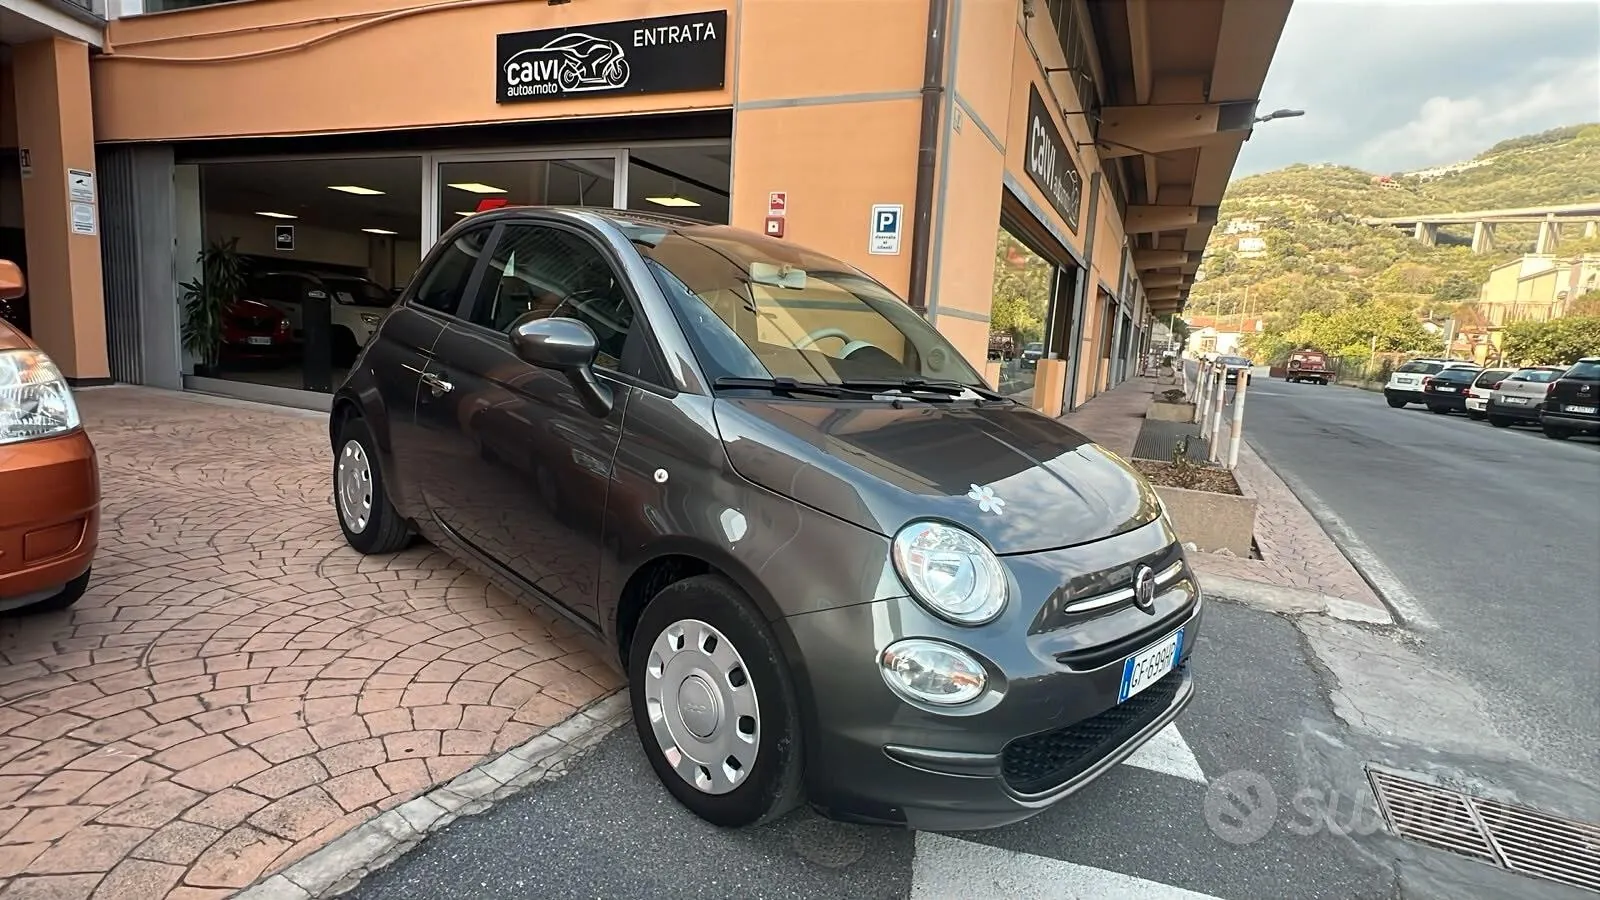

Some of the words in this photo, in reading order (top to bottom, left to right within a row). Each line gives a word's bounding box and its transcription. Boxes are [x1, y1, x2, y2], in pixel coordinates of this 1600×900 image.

[633, 22, 716, 47] ENTRATA
[507, 81, 558, 97] auto&moto
[879, 213, 894, 232] P
